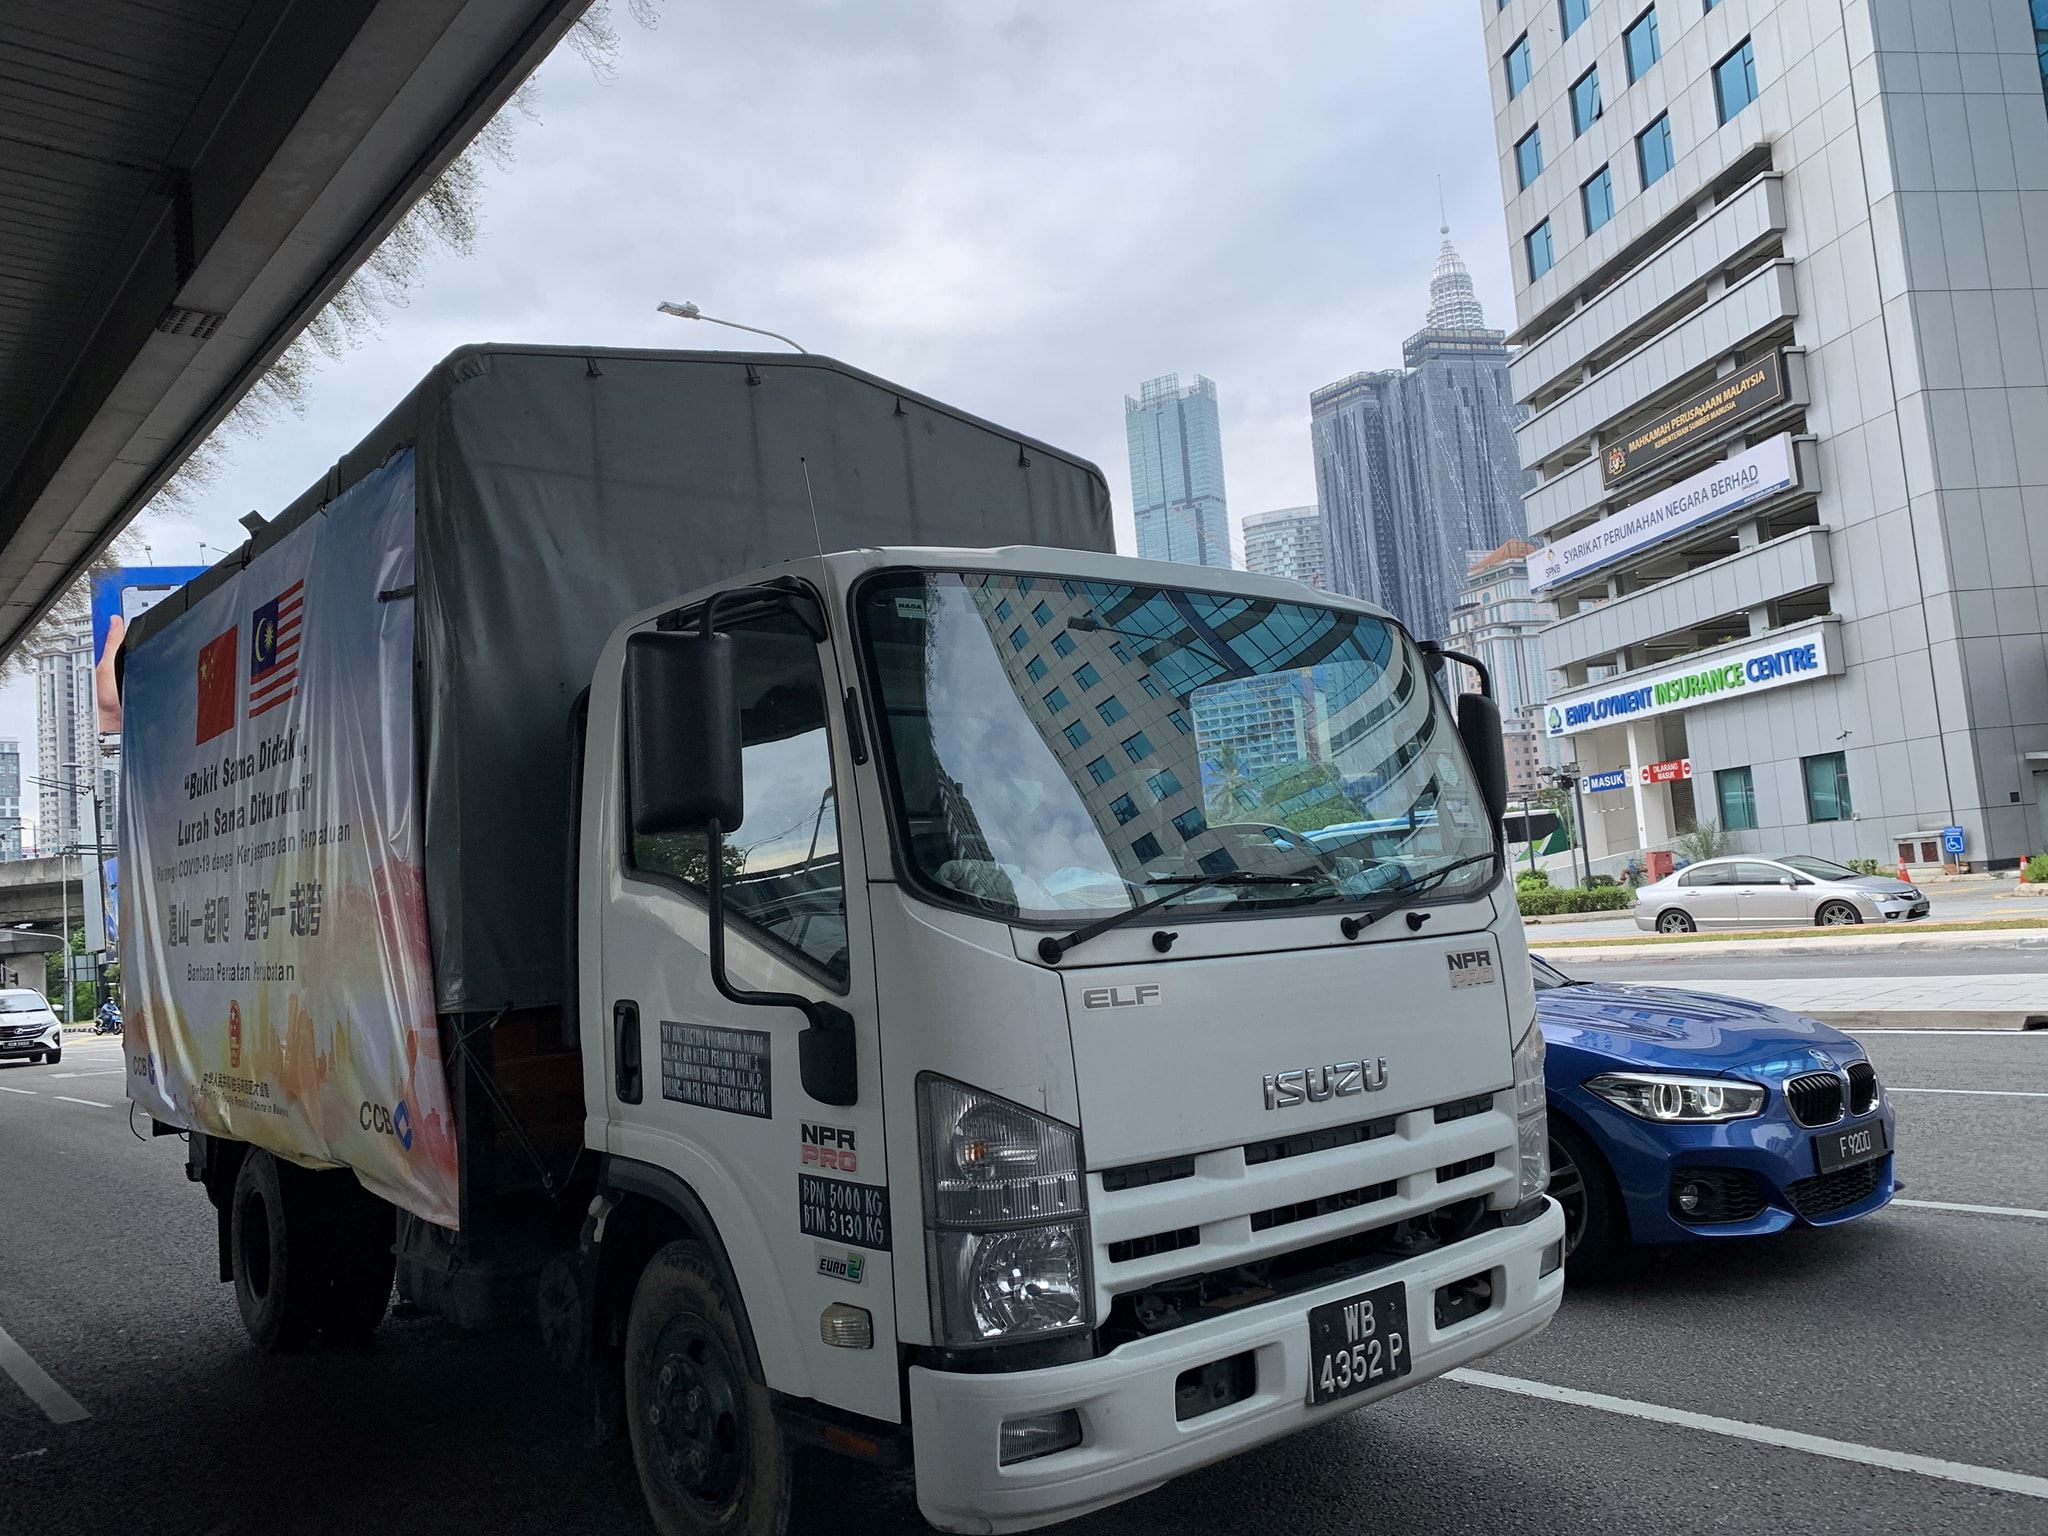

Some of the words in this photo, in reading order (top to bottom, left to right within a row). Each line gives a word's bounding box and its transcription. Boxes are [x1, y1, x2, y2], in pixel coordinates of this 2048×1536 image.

[1628, 422, 1670, 453] MAHKAMAH
[1670, 393, 1722, 431] PERUSAHAAN
[1723, 370, 1766, 402] MALAYSIA
[1654, 427, 1689, 449] KEMENTERIAN
[1688, 413, 1711, 431] SUMBER
[1710, 401, 1736, 421] MANUSIA
[1563, 535, 1603, 565] SYARIKAT
[1604, 507, 1664, 547] PERUMAHAN
[1665, 488, 1709, 519] NEGARA
[1710, 464, 1758, 499] BERHAD
[1565, 687, 1653, 726] EMPLOYMENT
[1654, 662, 1745, 706] INSURANCE
[1746, 643, 1818, 684] CENTRE
[1591, 774, 1624, 788] MASUK
[1653, 763, 1678, 774] DILARANG
[1657, 771, 1676, 780] MASUK
[178, 812, 209, 847] Lurah
[188, 963, 214, 981] Bantuan
[1447, 951, 1492, 970] NPR
[1450, 968, 1494, 988] PRO
[1083, 985, 1159, 1009] ELF
[1263, 1056, 1388, 1111] ISUZU
[360, 1101, 393, 1135] CCB
[801, 1123, 856, 1150] NPR
[1840, 1136, 1847, 1158] F
[1848, 1130, 1872, 1155] 9200
[802, 1144, 857, 1172] PRO
[803, 1179, 826, 1206] BDM
[830, 1184, 861, 1213] 5000
[865, 1189, 883, 1216] KG
[804, 1205, 827, 1233] BTM
[866, 1216, 884, 1245] KG
[820, 1258, 847, 1275] EURO
[1343, 1300, 1376, 1344] WB
[1320, 1340, 1383, 1393] 4352
[1388, 1332, 1403, 1371] P
